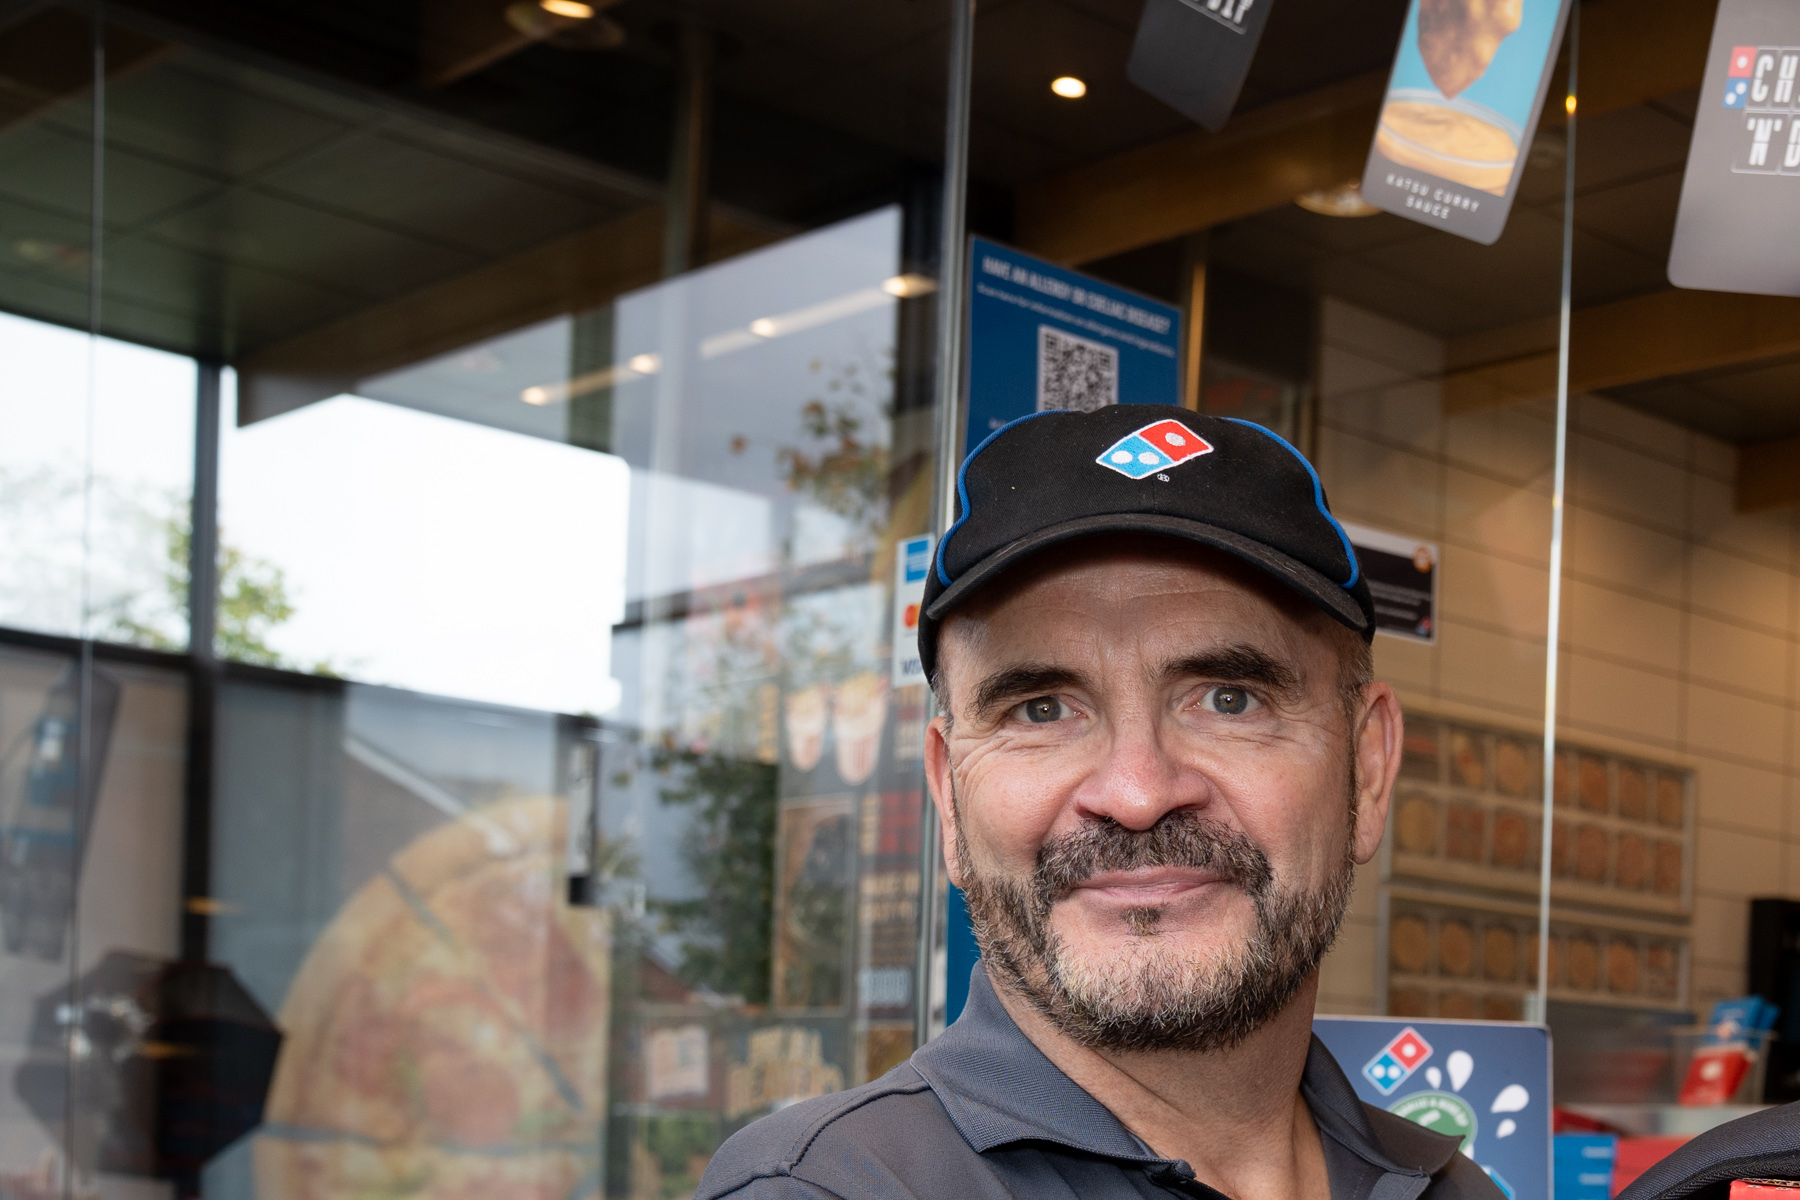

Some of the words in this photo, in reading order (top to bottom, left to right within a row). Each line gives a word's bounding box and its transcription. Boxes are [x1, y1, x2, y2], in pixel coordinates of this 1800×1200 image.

[1386, 173, 1430, 197] KATSU
[1433, 187, 1480, 213] CURRY
[1405, 195, 1451, 219] SAUCE
